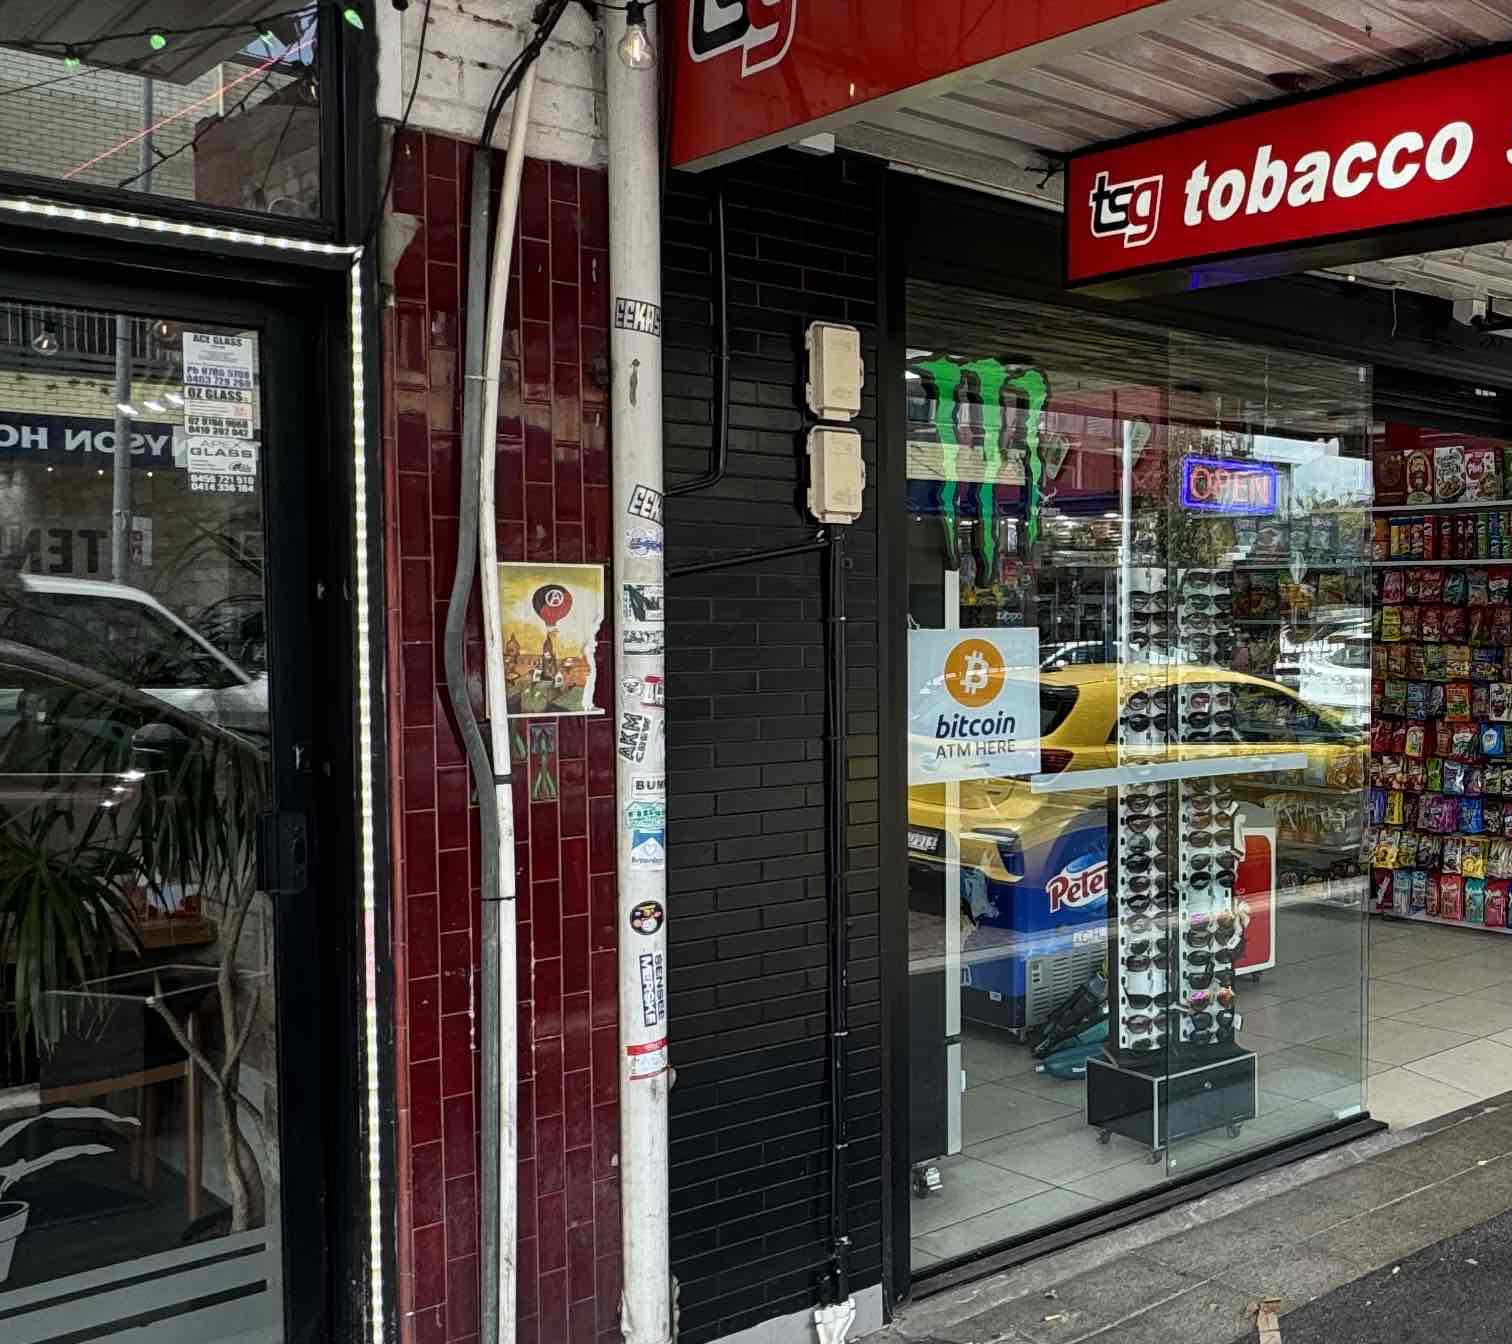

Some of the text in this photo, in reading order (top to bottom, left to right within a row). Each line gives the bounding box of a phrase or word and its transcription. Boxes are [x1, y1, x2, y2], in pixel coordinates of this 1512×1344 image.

[1184, 120, 1474, 228] tobacco
[213, 337, 242, 346] GLASS
[206, 389, 242, 401] GLASS
[190, 447, 252, 458] GLASS
[935, 711, 1016, 738] bitcoin
[936, 739, 1016, 759] ATM HERE
[1046, 860, 1108, 913] Pete
